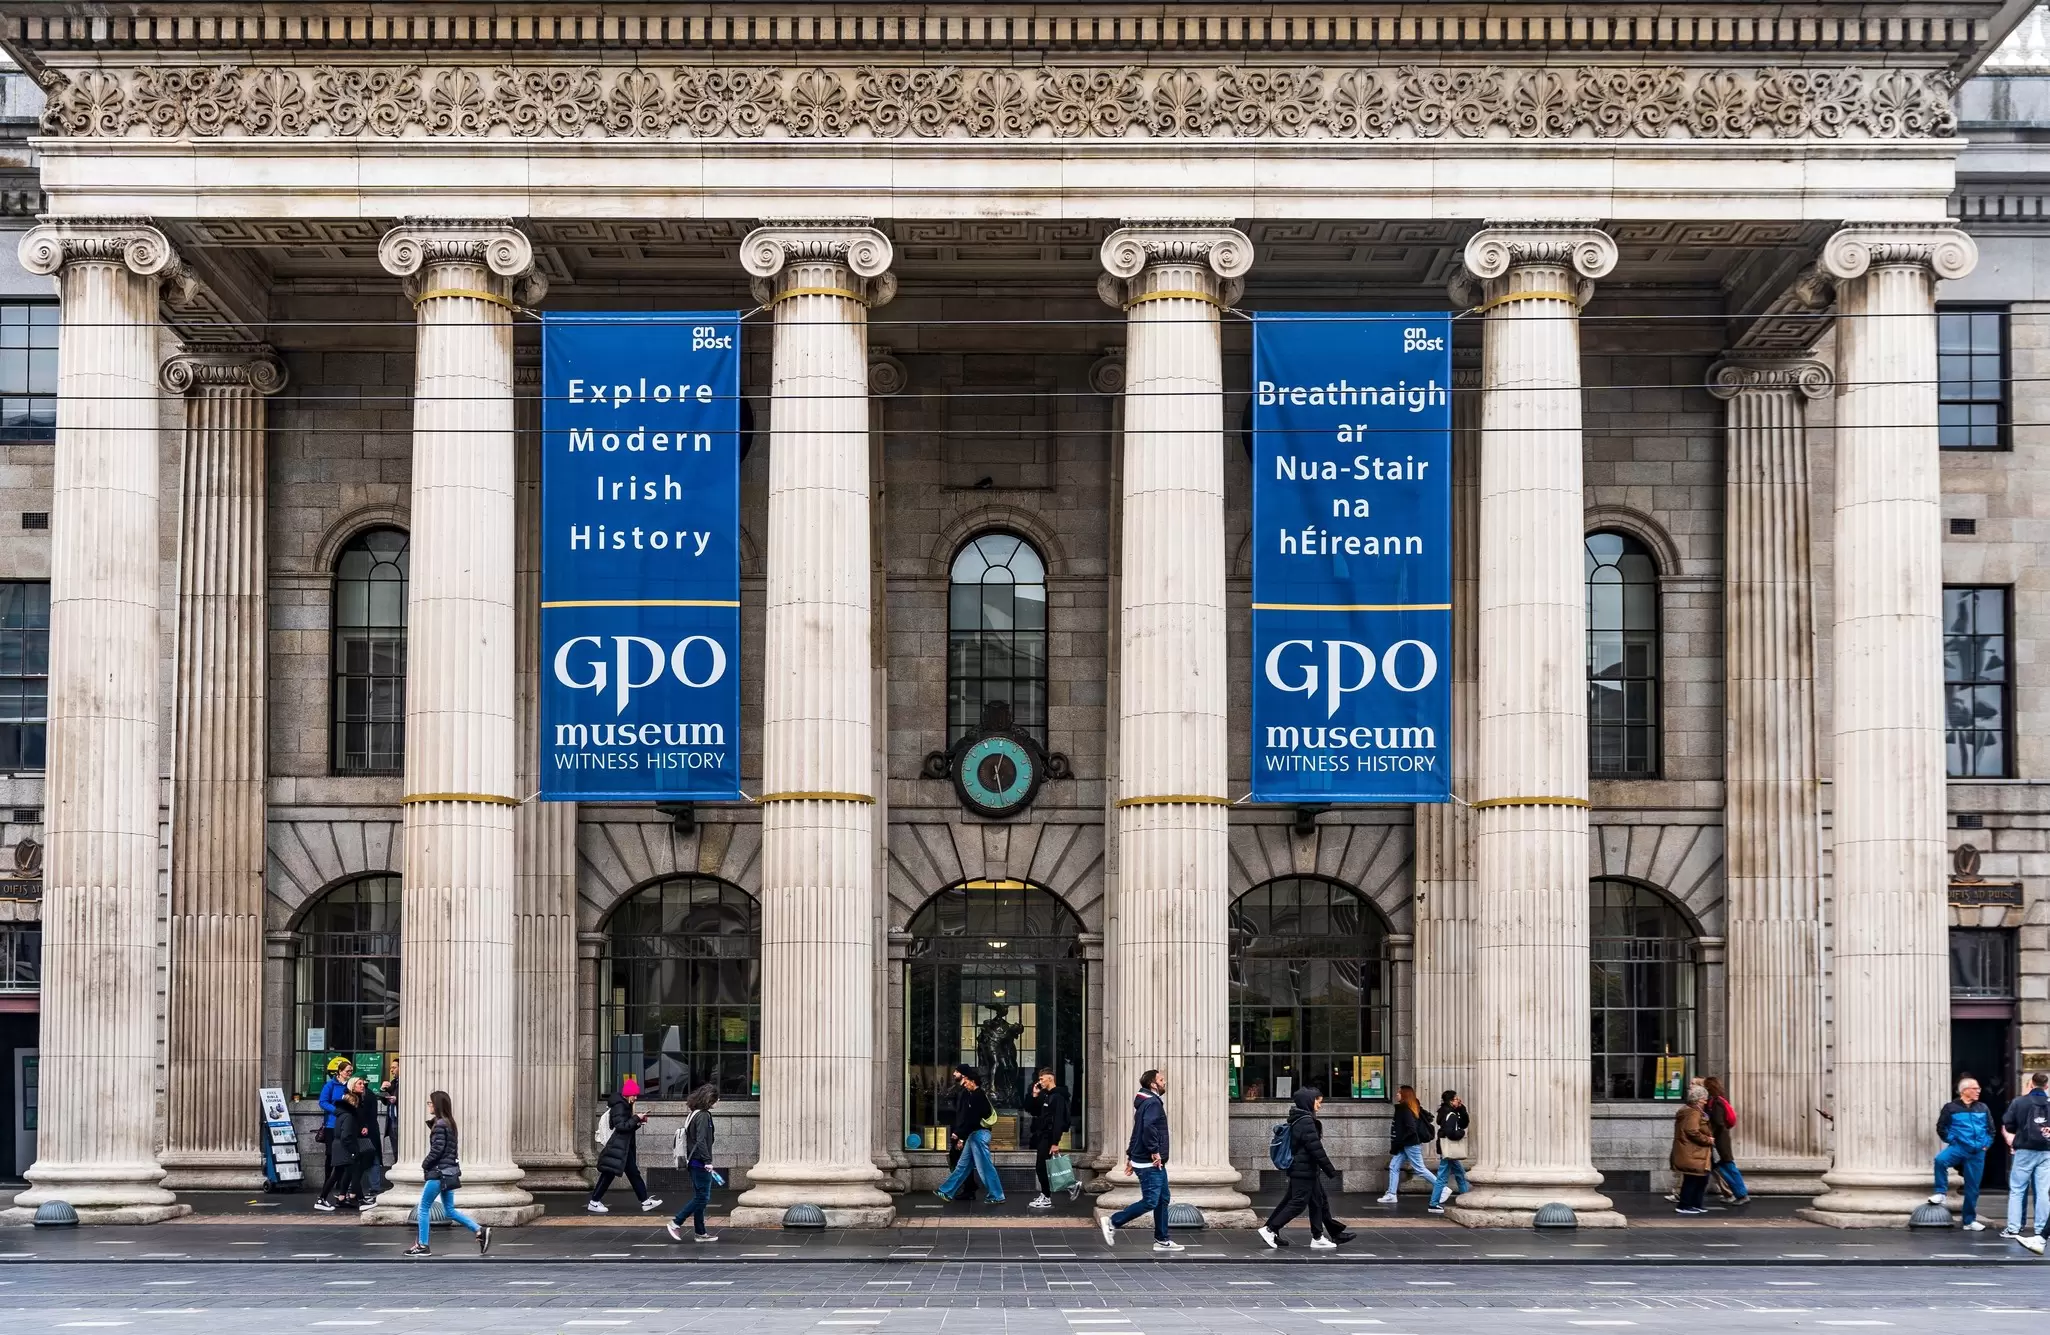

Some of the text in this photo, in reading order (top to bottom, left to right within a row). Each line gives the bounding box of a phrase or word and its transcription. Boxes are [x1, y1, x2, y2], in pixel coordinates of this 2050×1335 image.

[693, 327, 715, 337] an
[693, 334, 731, 351] post
[1404, 328, 1426, 339] an
[1405, 336, 1443, 353] post
[569, 378, 713, 409] Explore
[1259, 380, 1446, 412] Breathnaigh
[569, 426, 712, 452] Modern
[1337, 425, 1367, 442] ar
[1277, 456, 1428, 480] Nua-Stair
[598, 475, 681, 500] Irish
[1334, 499, 1368, 517] na
[571, 525, 710, 556] History
[1281, 526, 1422, 555] hÉireann
[556, 724, 725, 748] museum
[1266, 727, 1436, 751] museum
[555, 753, 724, 769] WITNESS HISTORY
[1266, 756, 1435, 771] WITNESS HISTORY
